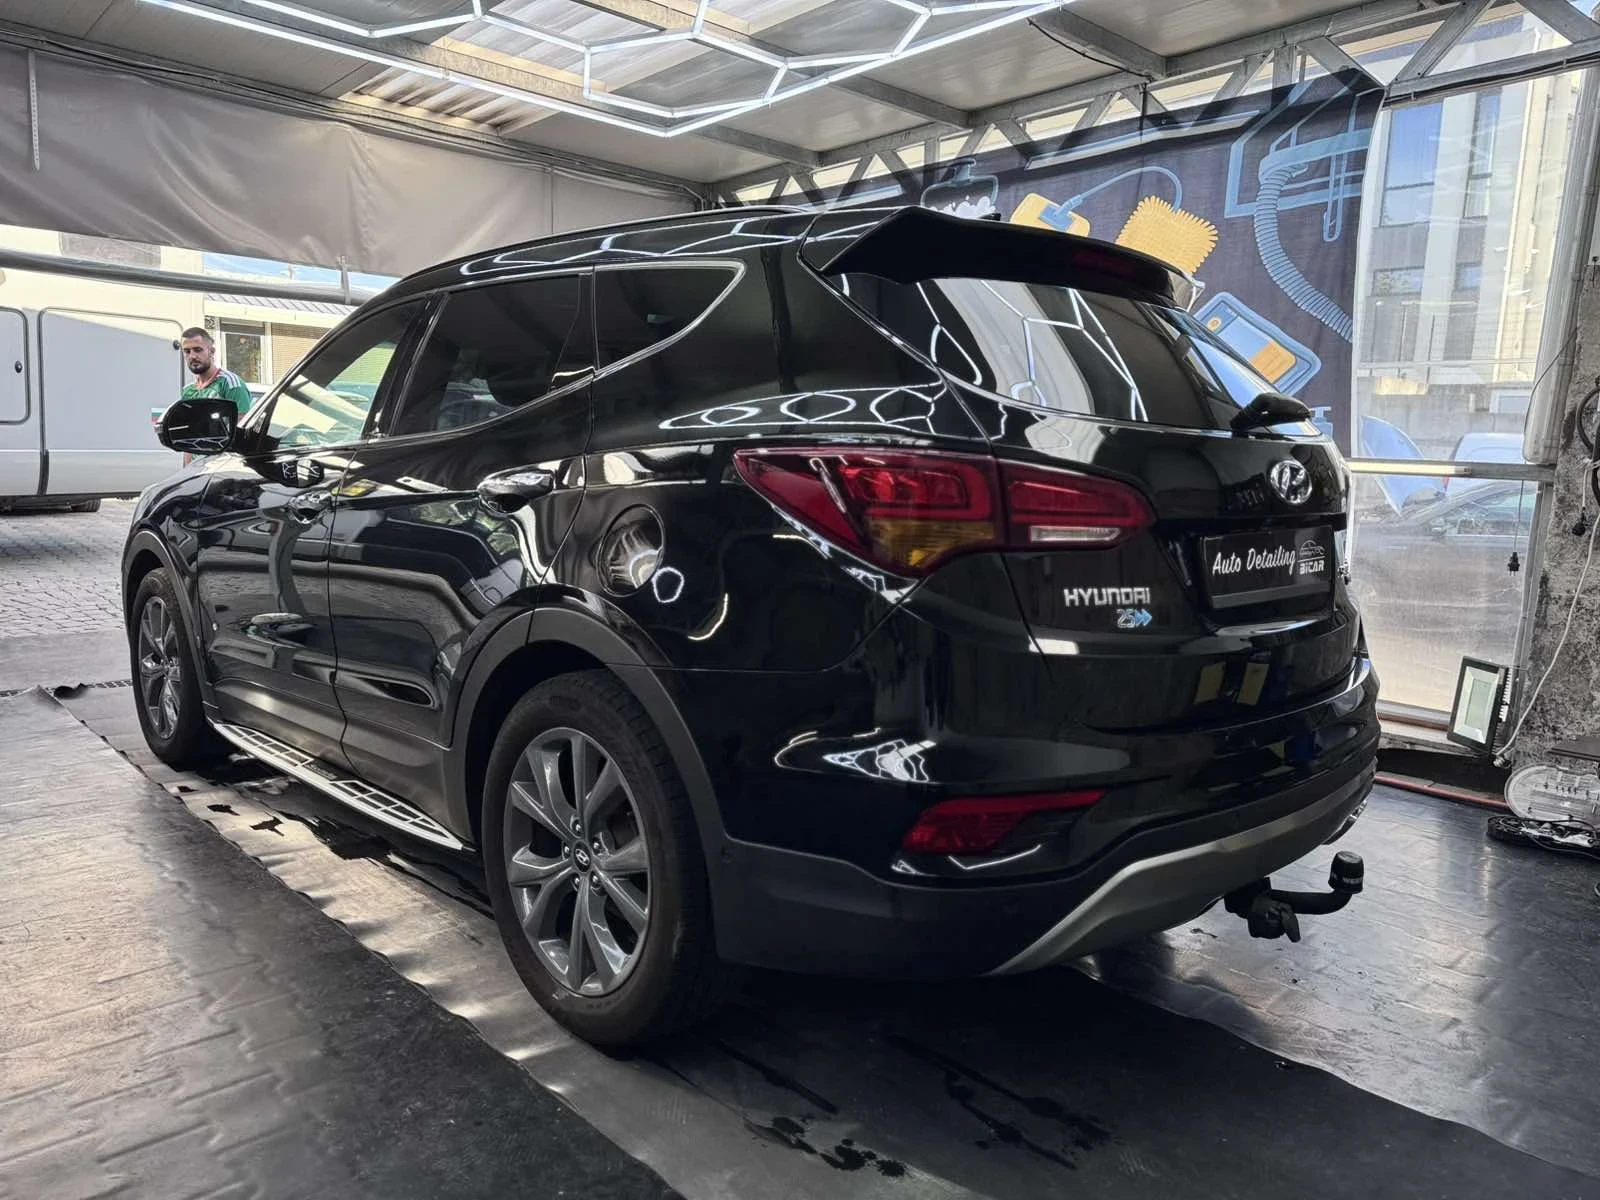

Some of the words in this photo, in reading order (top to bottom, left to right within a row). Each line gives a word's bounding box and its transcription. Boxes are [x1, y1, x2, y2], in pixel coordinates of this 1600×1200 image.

[1212, 551, 1242, 576] Auto
[1246, 545, 1297, 576] Detailing
[1063, 586, 1151, 607] HYUNDAI
